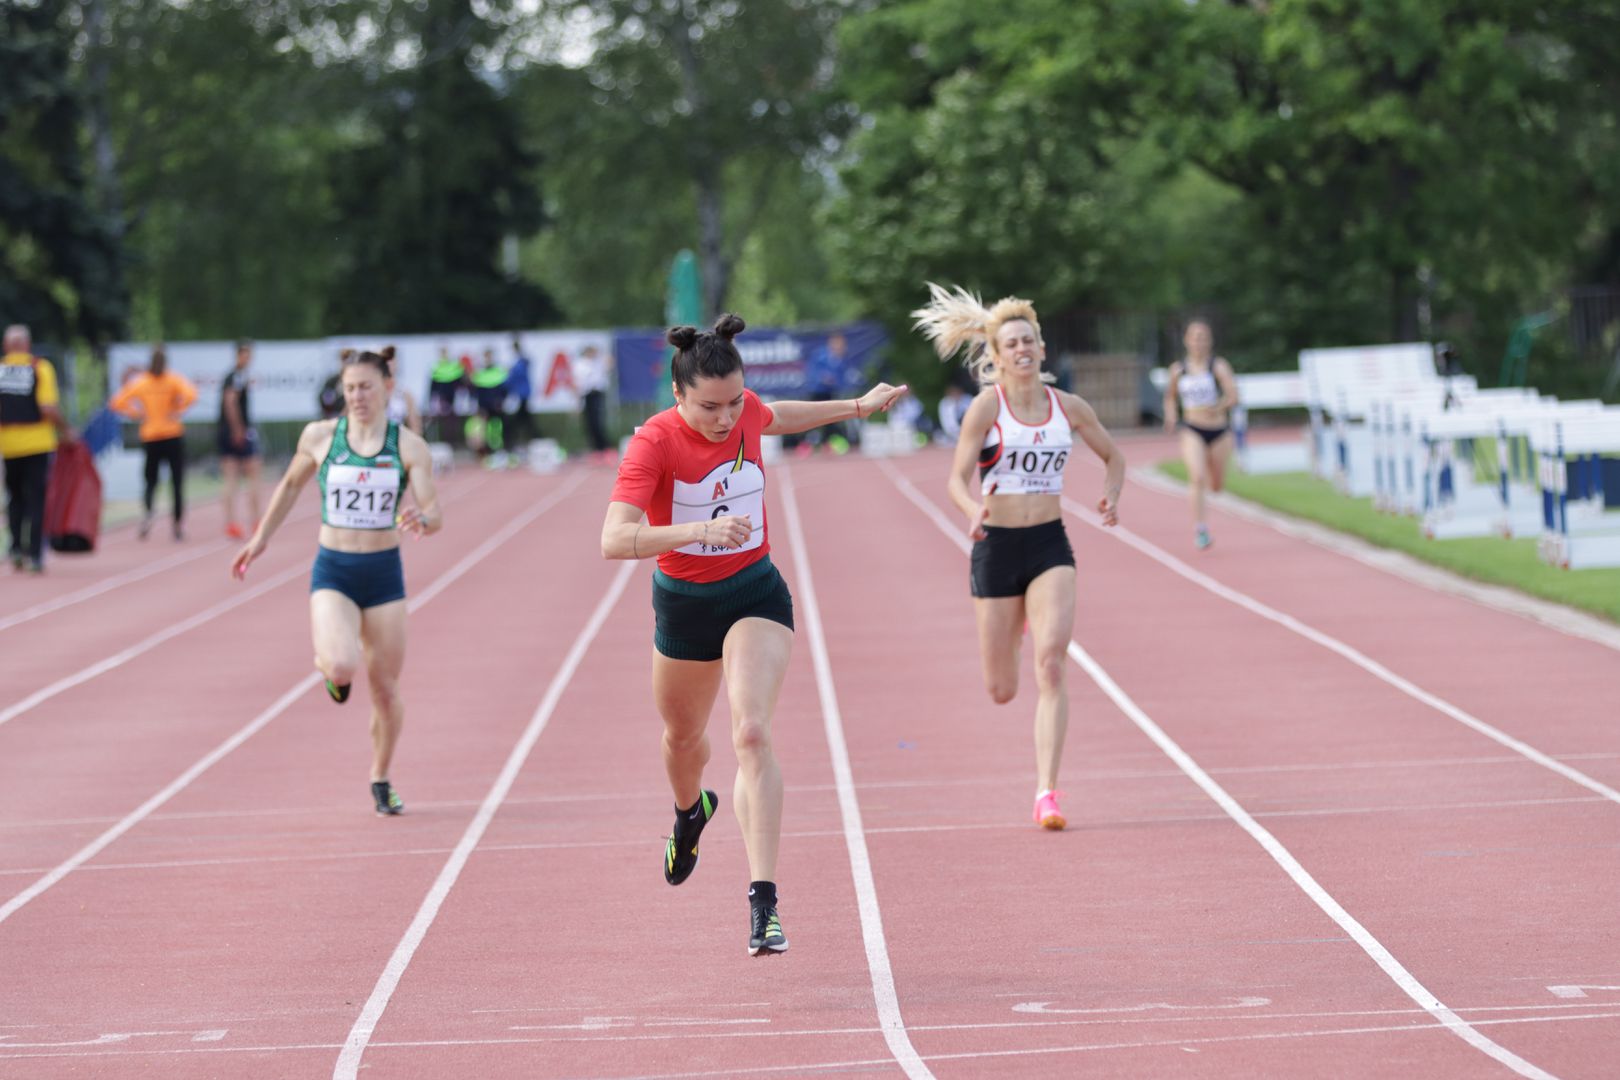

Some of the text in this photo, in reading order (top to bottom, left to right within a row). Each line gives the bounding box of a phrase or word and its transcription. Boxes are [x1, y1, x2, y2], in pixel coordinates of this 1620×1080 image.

[1007, 450, 1068, 473] 1076
[331, 488, 393, 512] 1212
[711, 477, 729, 501] A1
